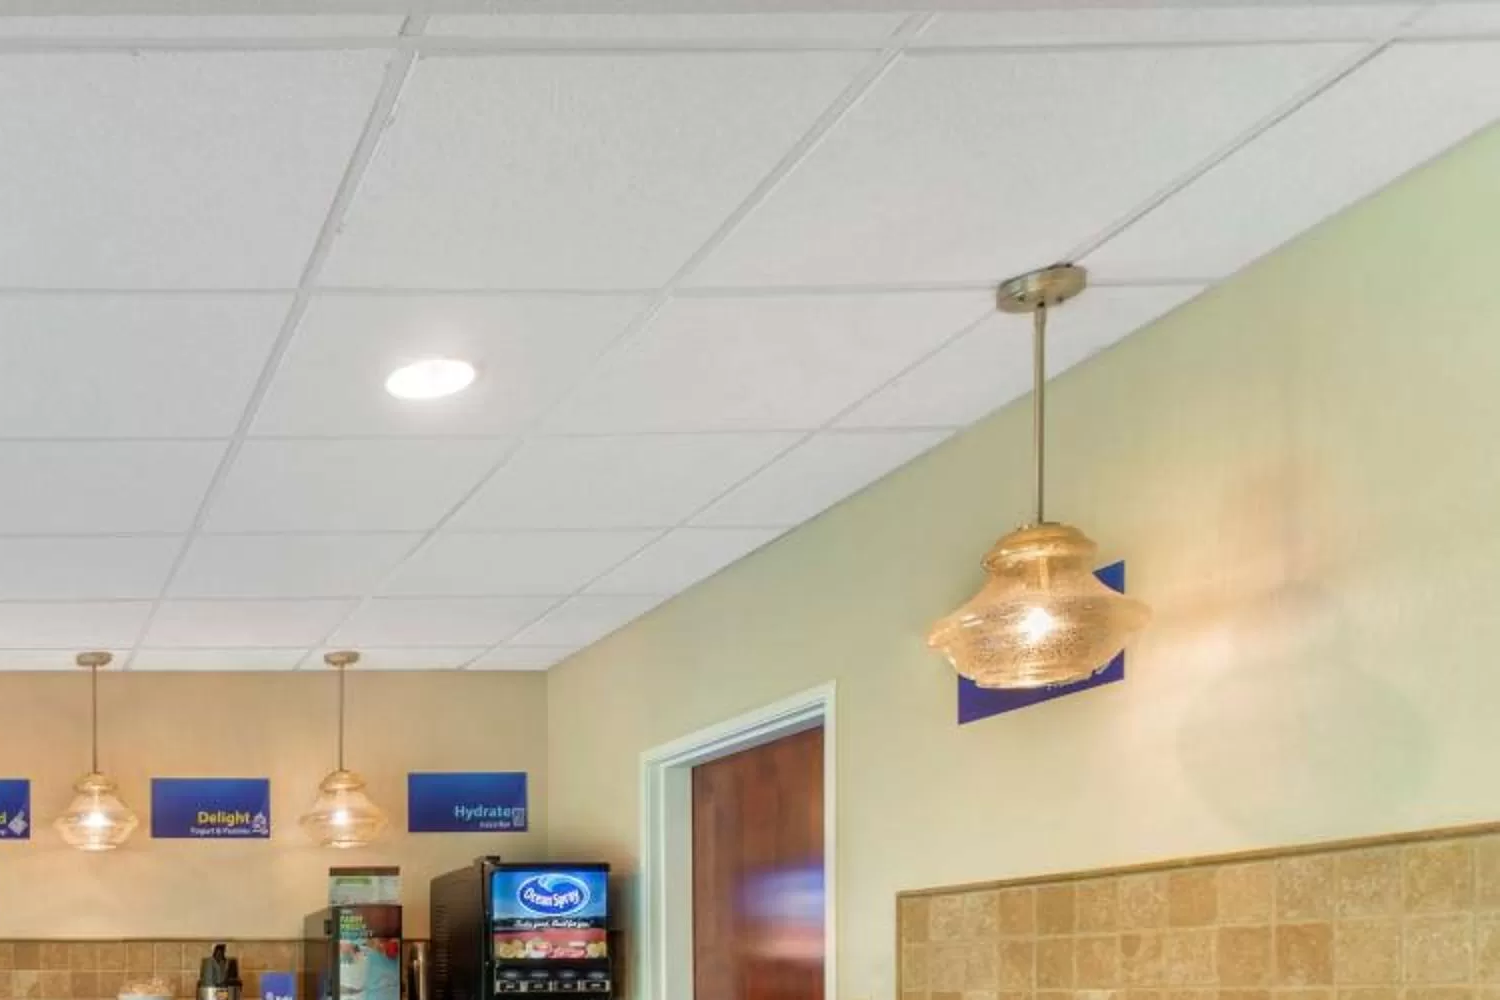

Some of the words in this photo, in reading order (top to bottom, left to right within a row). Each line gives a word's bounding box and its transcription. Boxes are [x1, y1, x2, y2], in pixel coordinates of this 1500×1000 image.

[198, 811, 250, 826] Delight
[455, 805, 510, 822] Hydrate
[523, 887, 553, 906] Ocean
[553, 889, 580, 908] Spray
